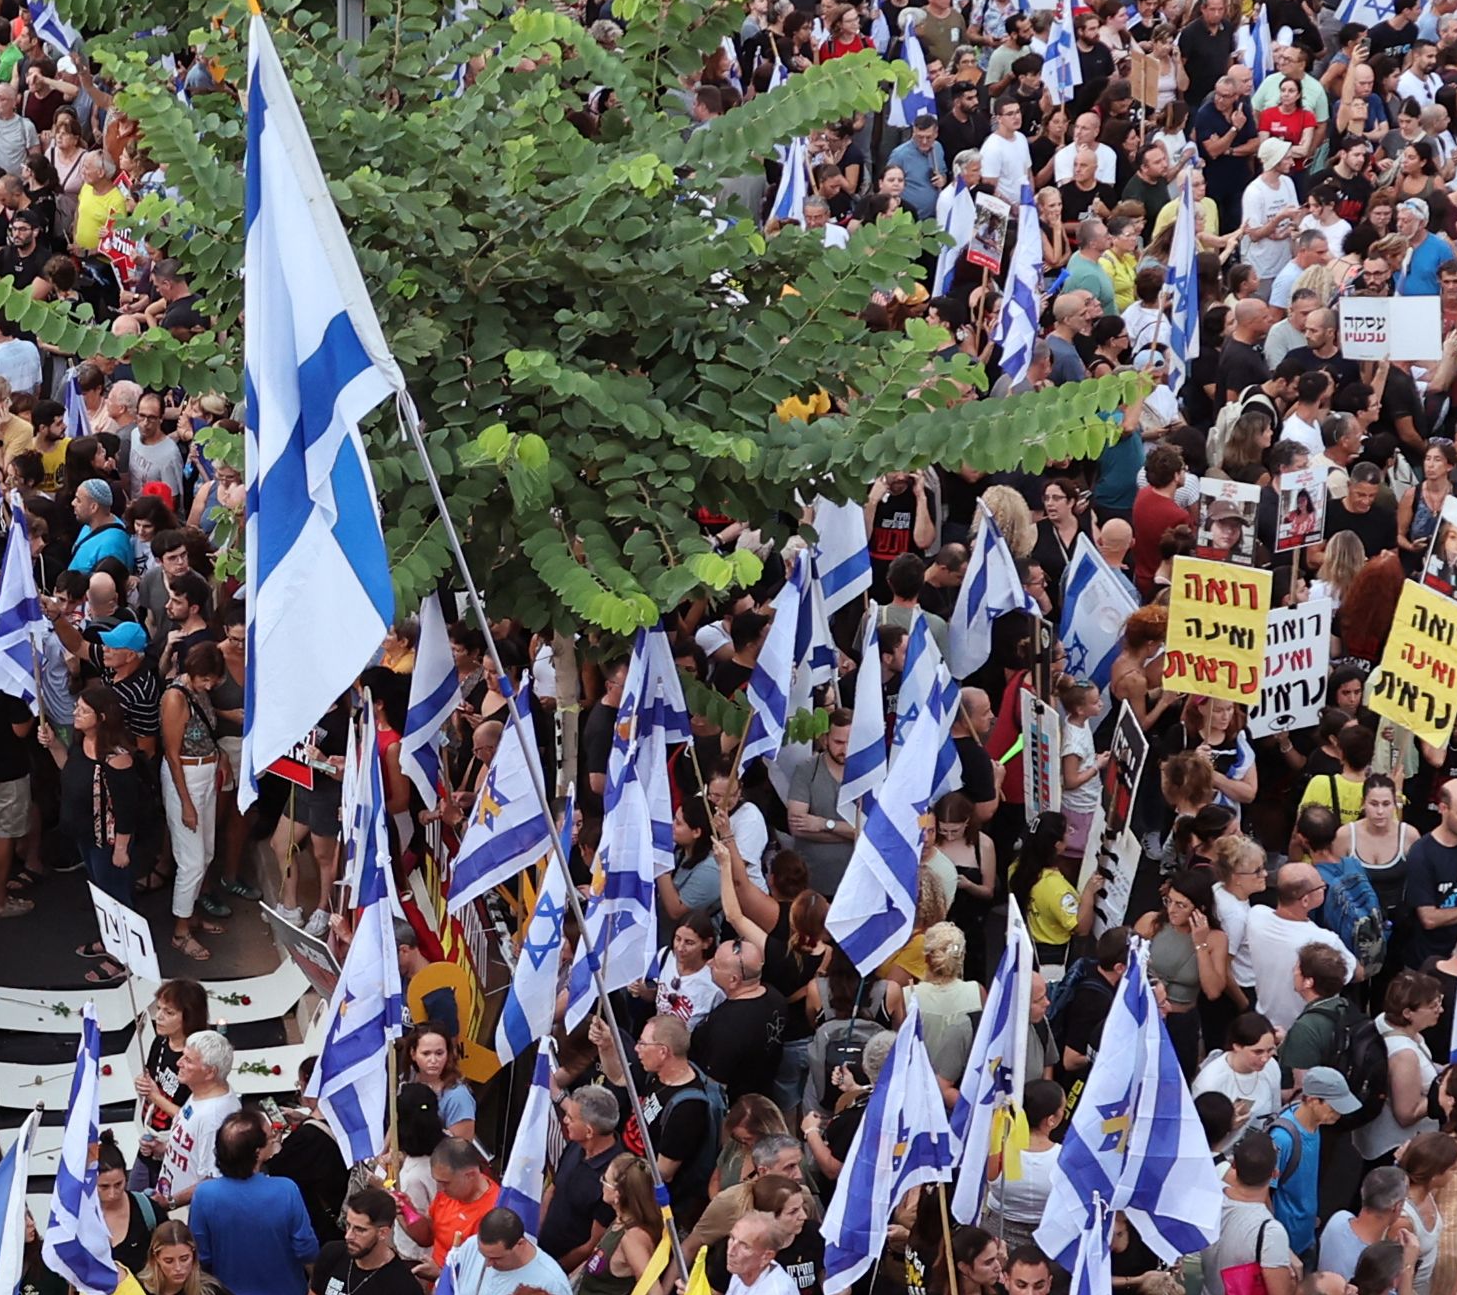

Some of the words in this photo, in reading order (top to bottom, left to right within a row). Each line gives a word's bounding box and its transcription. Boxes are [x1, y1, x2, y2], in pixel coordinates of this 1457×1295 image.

[1344, 316, 1386, 331] עסקה
[1344, 332, 1386, 343] עכשיו
[1182, 572, 1260, 611] רואה
[1184, 616, 1255, 652] ואינה
[1266, 611, 1323, 648] רואה
[1162, 647, 1260, 694] נראית
[1399, 641, 1457, 689] ואינה
[1373, 668, 1454, 730] נראית
